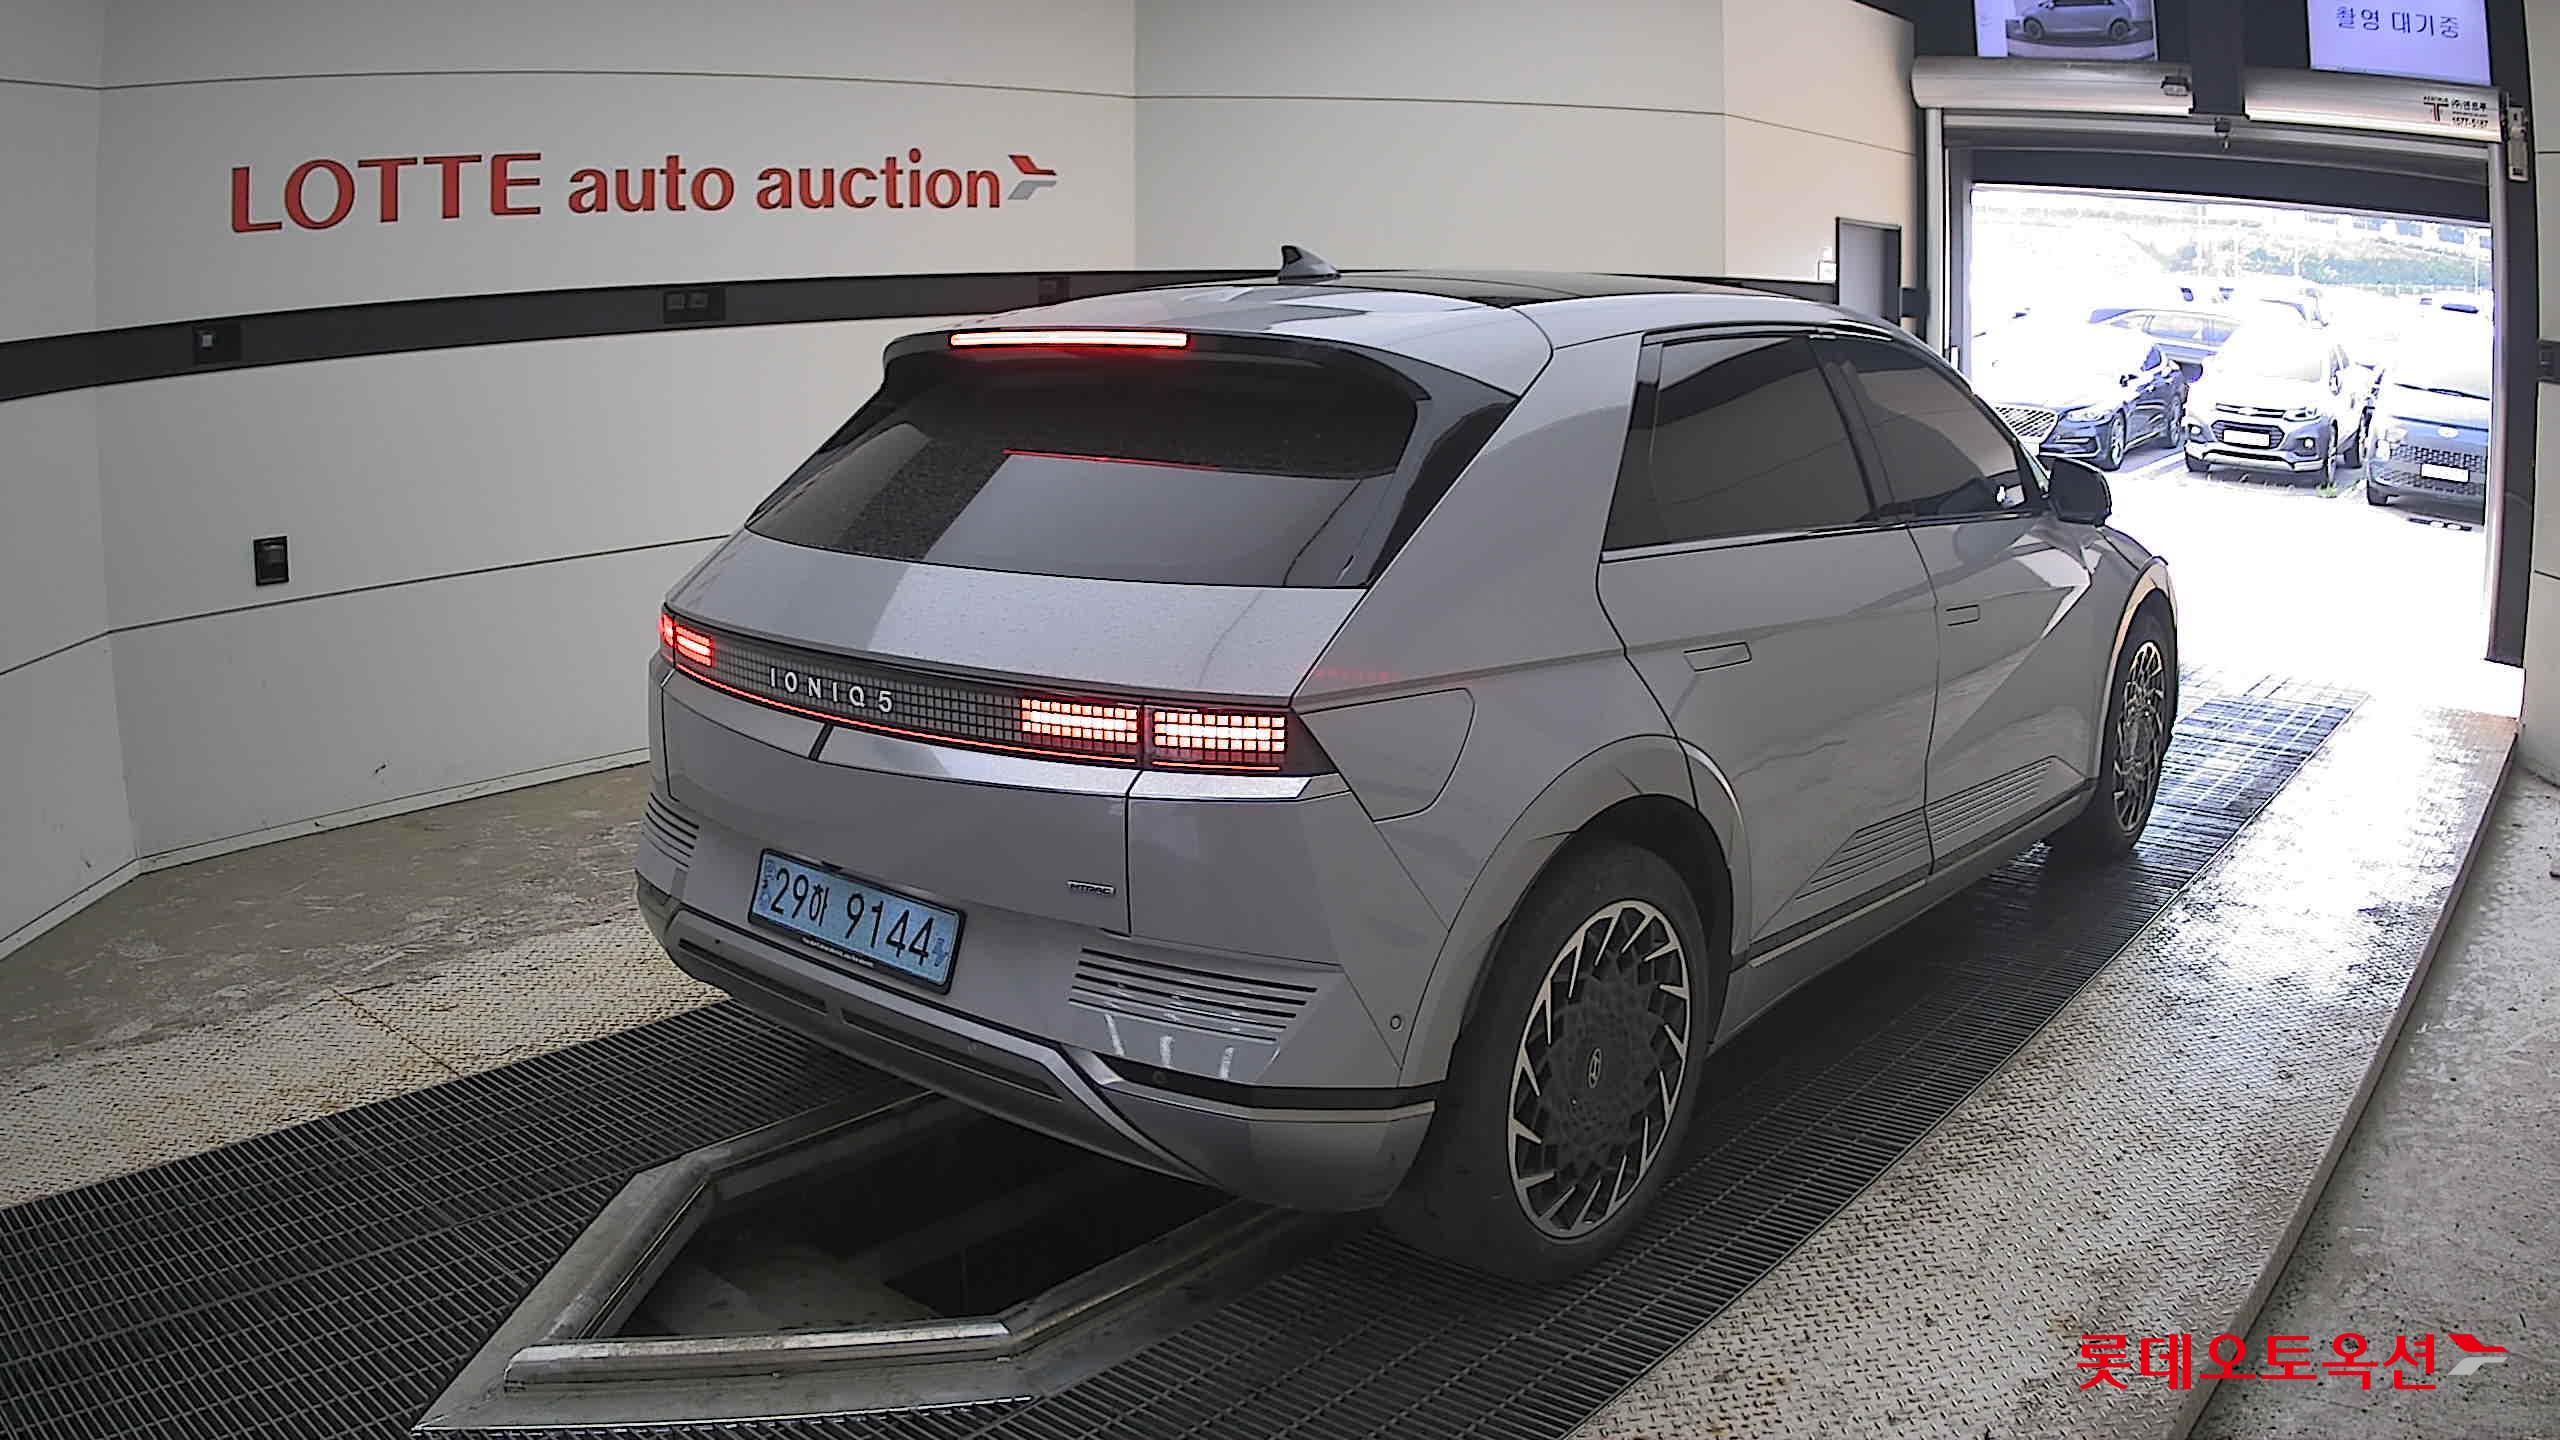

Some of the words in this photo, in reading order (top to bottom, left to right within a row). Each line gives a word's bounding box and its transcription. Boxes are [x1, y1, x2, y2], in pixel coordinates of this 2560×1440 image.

[2336, 6, 2380, 31] 촬영
[2392, 12, 2459, 39] 대기중
[232, 153, 543, 233] LOTTE
[569, 155, 736, 212] auto
[757, 148, 1003, 210] auction
[770, 867, 830, 927] 29하
[846, 893, 934, 966] 9144
